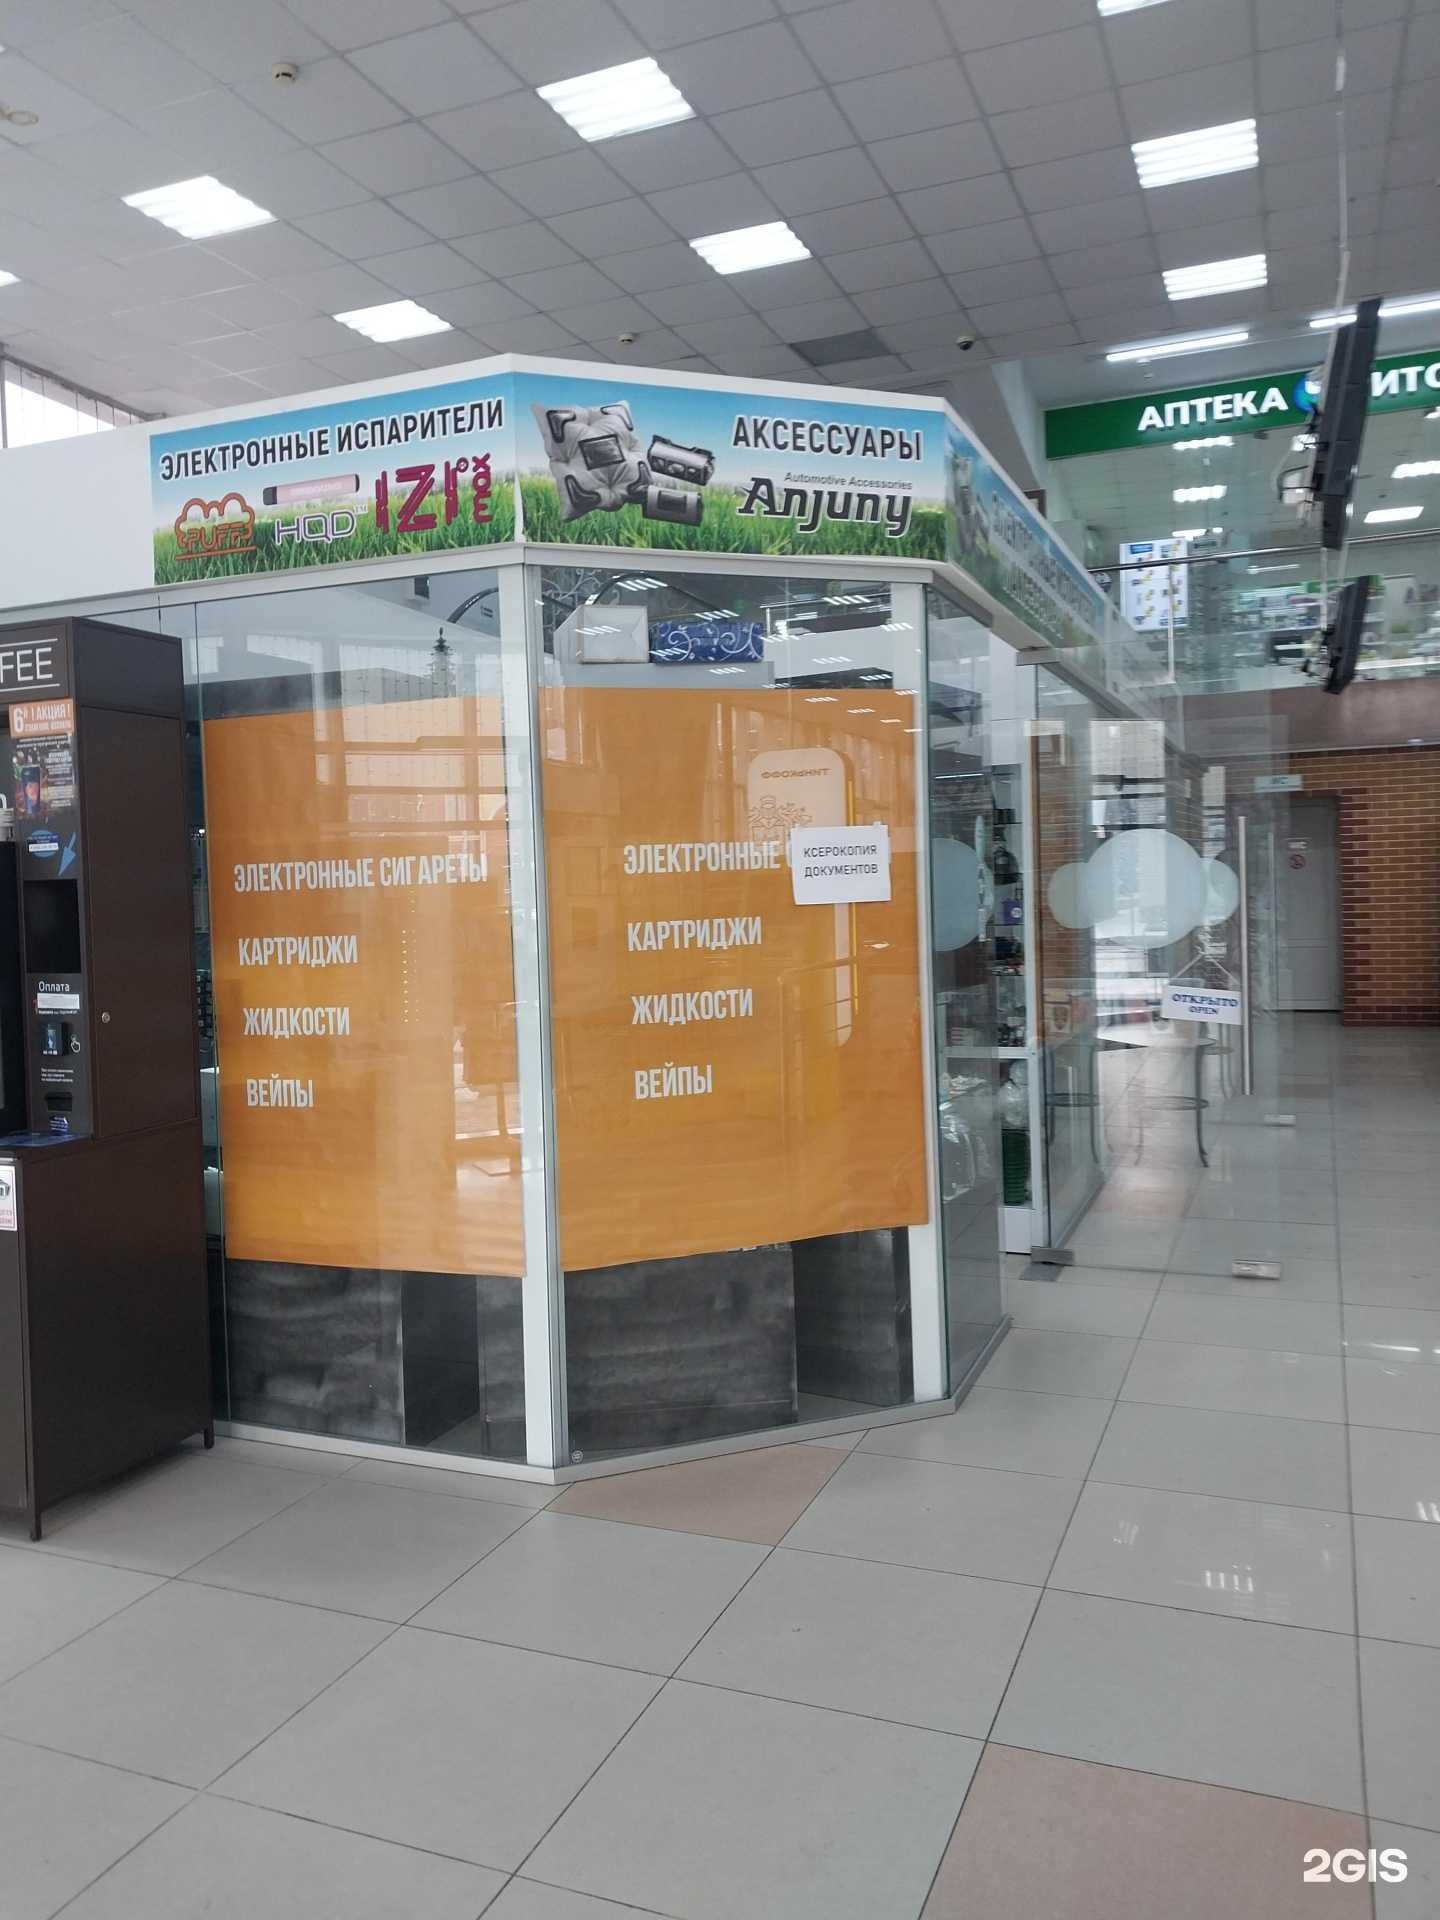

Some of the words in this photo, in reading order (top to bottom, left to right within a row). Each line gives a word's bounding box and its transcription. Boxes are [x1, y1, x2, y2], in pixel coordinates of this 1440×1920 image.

[1137, 386, 1289, 431] АПТЕКА
[160, 428, 330, 481] ЭЛЕКТРОННЫЕ
[337, 398, 504, 453] ИСПАРИТЕЛИ
[732, 416, 922, 461] АКСЕССУАРЫ
[784, 472, 847, 486] Automotive
[848, 476, 913, 490] Accessories
[737, 477, 913, 538] Anjuny
[275, 509, 356, 544] HQD
[623, 840, 782, 875] ЭЛЕКТРОННЫЕ
[803, 845, 878, 859] КСЕРОКОПИЯ
[234, 858, 375, 893] ЭЛЕКТРОННЫЕ
[380, 853, 489, 886] СИГАРЕТЫ
[804, 864, 879, 878] ДОКУМЕНТОВ
[238, 935, 359, 967] КАРТРИДЖИ
[627, 916, 763, 951] КАРТРИДЖИ
[38, 980, 71, 993] Оплата
[1172, 993, 1239, 1008] ОТКРЫТО
[243, 1007, 351, 1039] ЖИДКОСТИ
[632, 988, 753, 1026] ЖИДКОСТИ
[1189, 1006, 1218, 1015] OPEN
[246, 1073, 315, 1107] ВЕЙПЫ
[634, 1061, 713, 1100] ВЕЙПЫ
